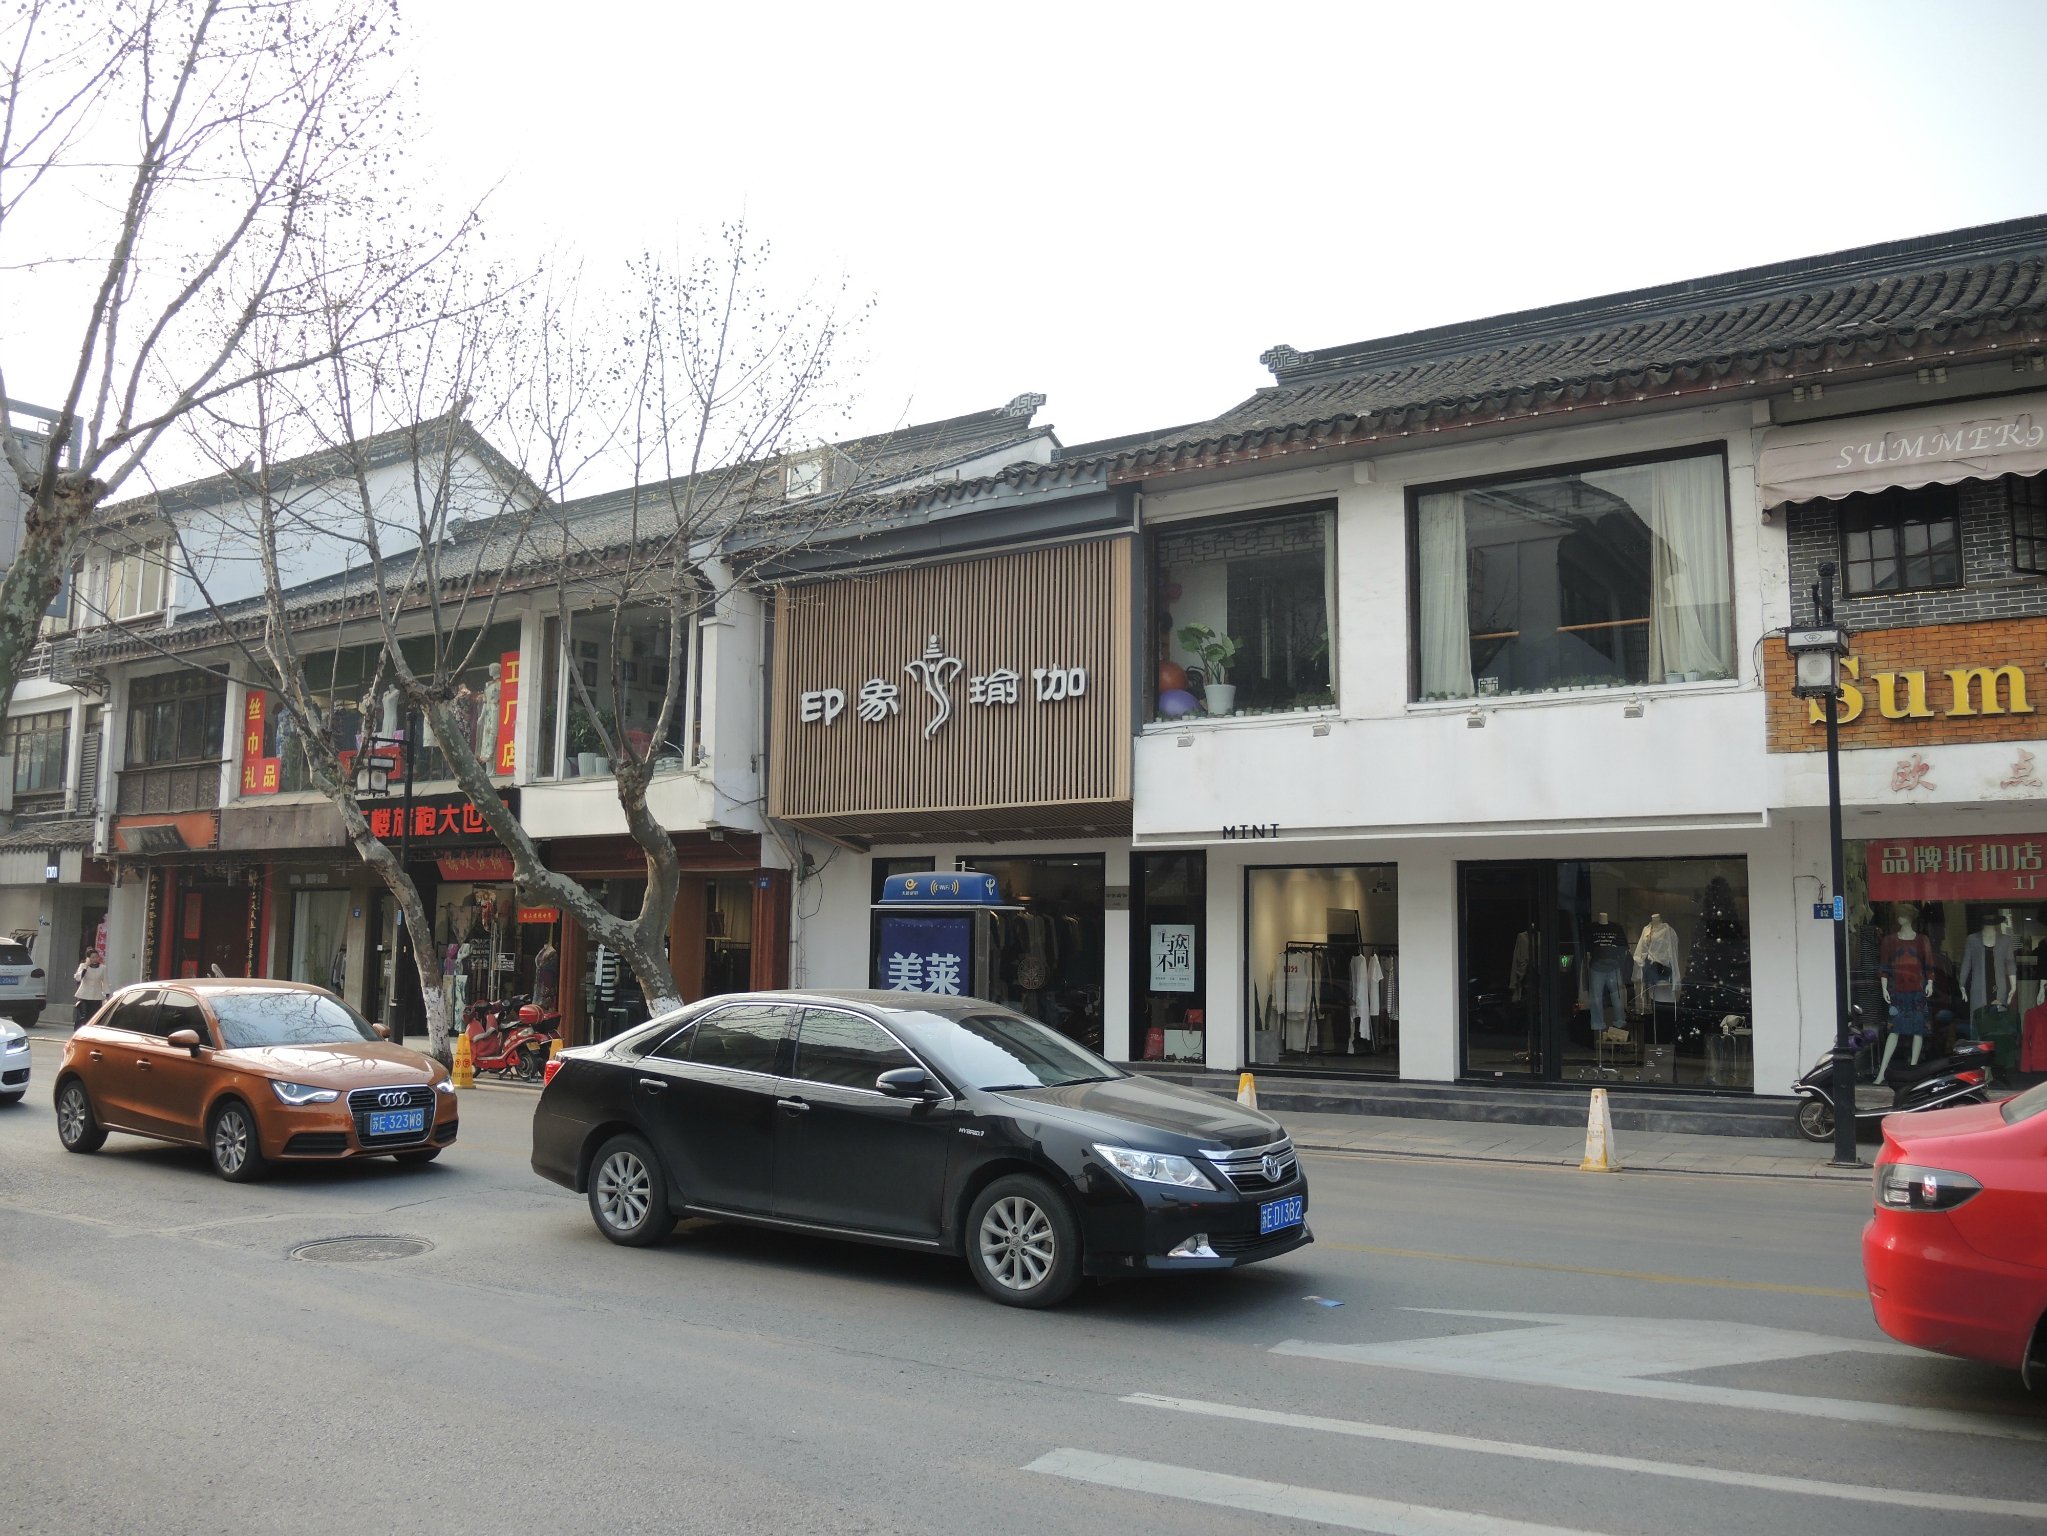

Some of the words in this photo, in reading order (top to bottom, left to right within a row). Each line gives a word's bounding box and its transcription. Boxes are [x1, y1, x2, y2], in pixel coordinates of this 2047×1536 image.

[801, 678, 900, 726] 印象
[969, 667, 1087, 706] 瑜伽
[244, 764, 276, 789] 礼品
[1223, 824, 1279, 839] MINI
[1881, 842, 2043, 874] 品牌折扣店
[888, 952, 961, 996] 美莱
